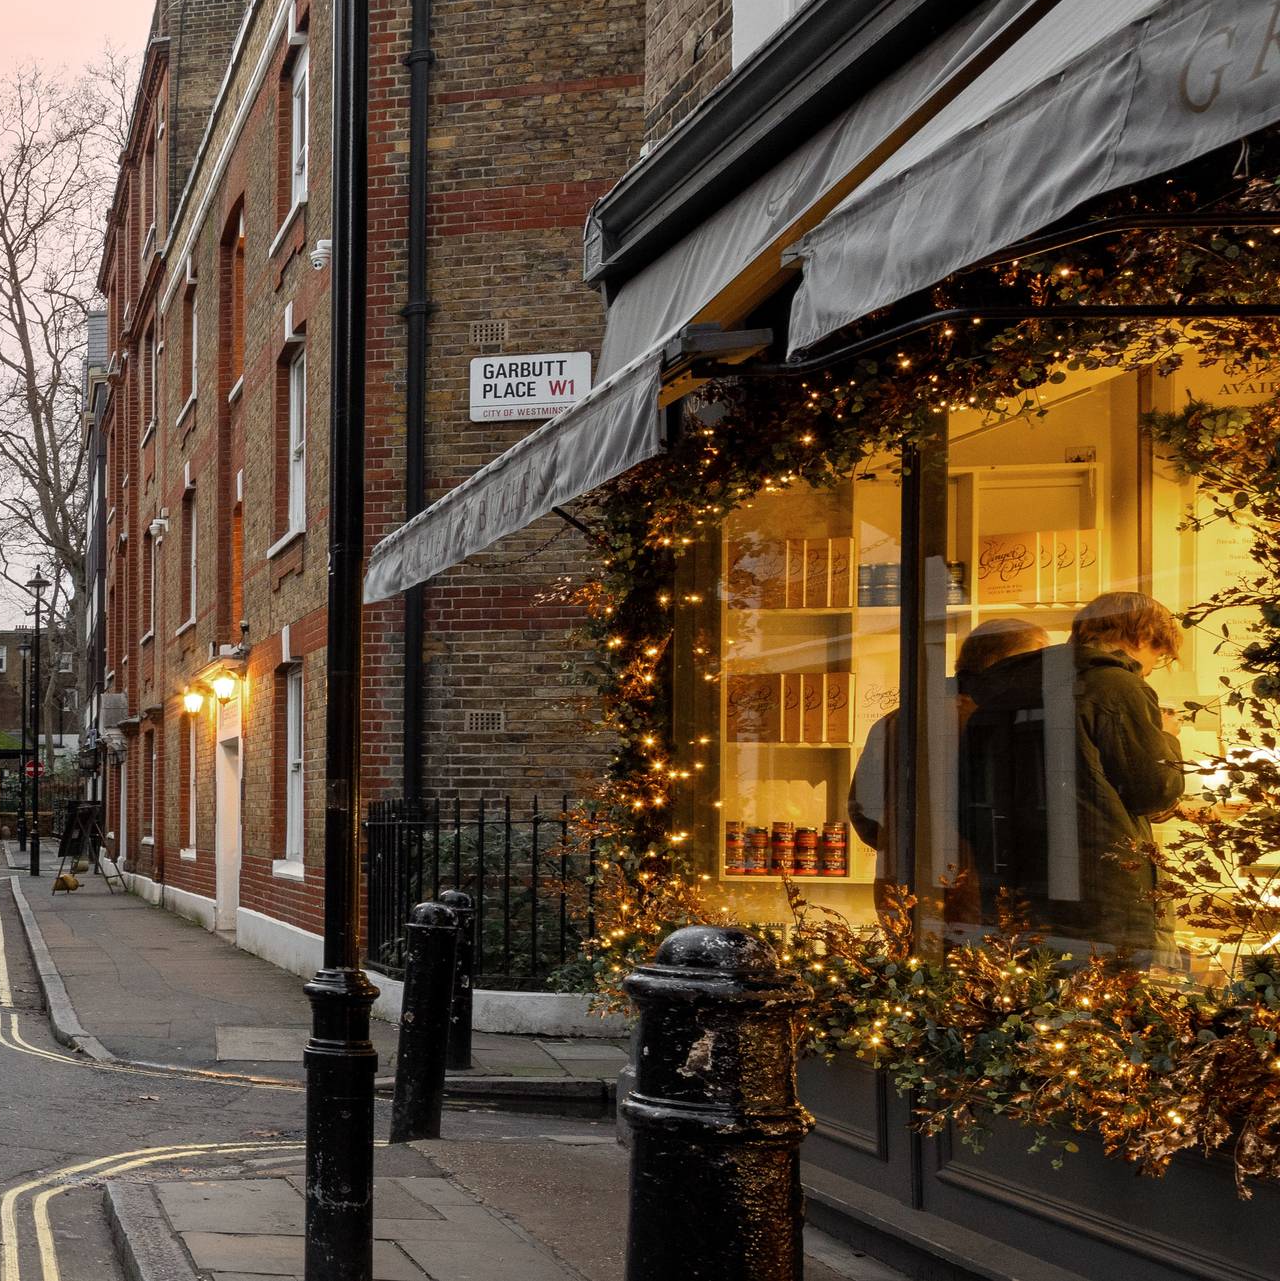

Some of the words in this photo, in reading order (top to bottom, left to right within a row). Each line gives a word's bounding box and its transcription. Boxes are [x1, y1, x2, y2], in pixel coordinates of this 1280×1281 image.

[483, 360, 567, 380] GARBUTT
[483, 381, 537, 399] PLACE
[548, 379, 575, 396] W1
[483, 409, 502, 418] CITY
[503, 409, 515, 417] OF
[517, 406, 568, 416] WESTMINS
